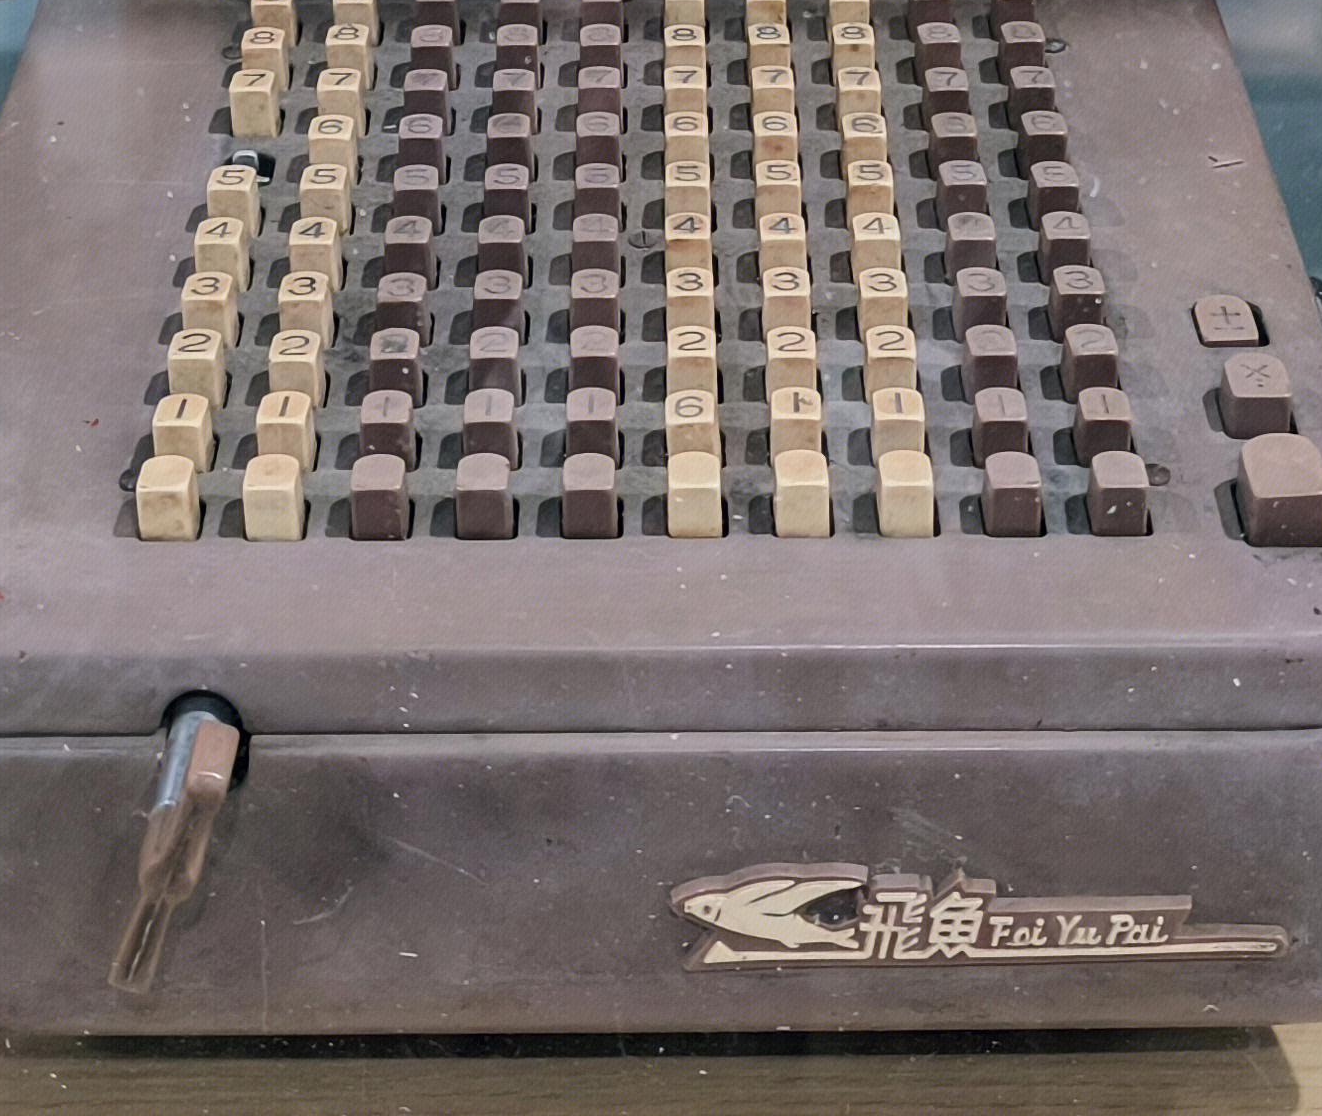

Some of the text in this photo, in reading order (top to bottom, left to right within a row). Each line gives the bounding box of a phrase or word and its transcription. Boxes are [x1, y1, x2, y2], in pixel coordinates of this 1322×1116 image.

[249, 30, 275, 45] 8
[333, 26, 360, 41] 8
[671, 27, 697, 42] 8
[756, 25, 781, 40] 8
[840, 25, 866, 40] 8
[242, 72, 266, 87] 7
[328, 71, 353, 86] 7
[502, 71, 529, 87] 7
[587, 68, 614, 83] 7
[672, 69, 698, 84] 7
[760, 69, 786, 84] 7
[844, 70, 870, 86] 7
[932, 70, 958, 87] 7
[1018, 69, 1044, 84] 7
[317, 118, 344, 135] 6
[672, 115, 699, 132] 6
[761, 115, 788, 132] 6
[850, 116, 880, 133] 6
[215, 168, 246, 186] 5
[304, 167, 337, 185] 5
[492, 167, 521, 185] 5
[673, 164, 702, 182] 5
[764, 164, 793, 181] 5
[855, 163, 885, 181] 5
[950, 163, 976, 181] 5
[204, 220, 232, 239] 4
[297, 220, 327, 239] 4
[672, 216, 702, 234] 4
[767, 216, 797, 235] 4
[861, 216, 891, 235] 4
[189, 276, 221, 296] 3
[287, 276, 318, 296] 3
[674, 272, 704, 292] 3
[771, 271, 801, 291] 3
[868, 272, 899, 292] 3
[1063, 269, 1094, 290] 3
[177, 332, 213, 353] 2
[278, 335, 311, 356] 2
[675, 331, 708, 352] 2
[775, 331, 808, 352] 2
[874, 330, 908, 351] 2
[674, 395, 704, 418] 6
[1056, 914, 1103, 946] Yu
[1105, 913, 1170, 946] Pai
